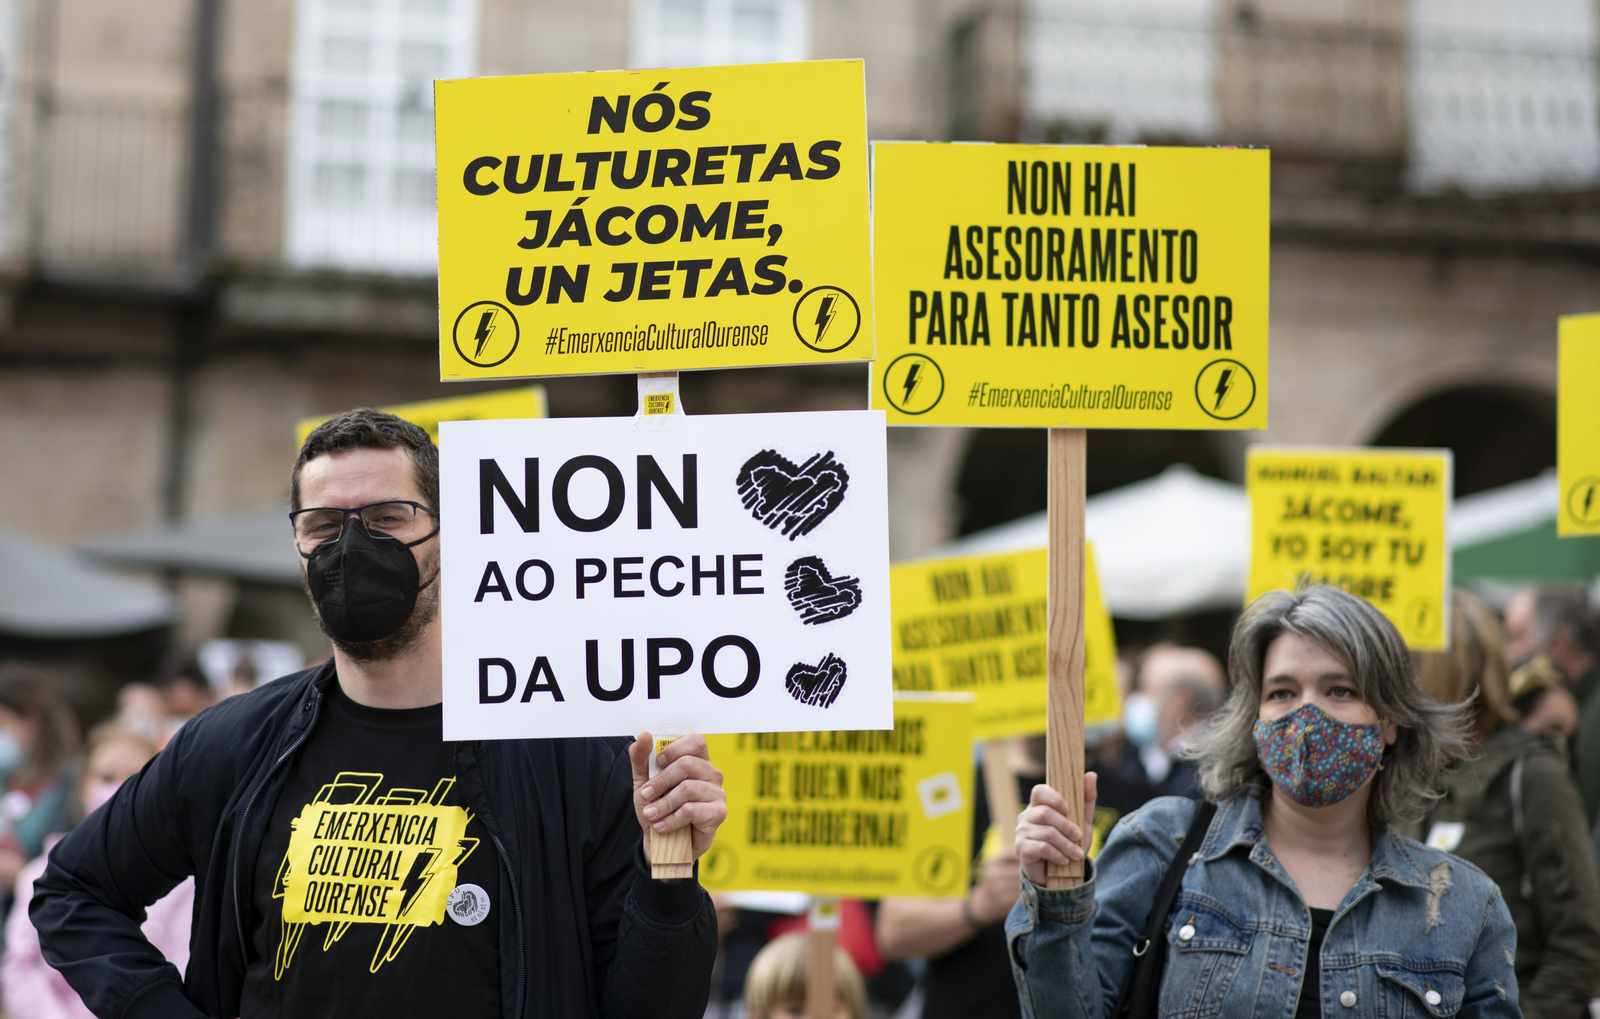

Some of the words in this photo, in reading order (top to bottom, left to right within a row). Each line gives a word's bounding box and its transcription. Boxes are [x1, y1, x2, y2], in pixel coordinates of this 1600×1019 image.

[587, 82, 712, 134] NÓS
[463, 140, 841, 196] CULTURETAS
[1007, 161, 1071, 215] NON
[1084, 163, 1136, 216] HAI
[517, 197, 783, 249] JÁCOME,
[505, 265, 589, 306] UN
[603, 255, 803, 302] JETAS.
[944, 226, 1198, 284] ASESORAMENTO
[545, 321, 769, 355] #EmerxenciaCulturalOurense
[909, 291, 991, 346] PARA
[1002, 293, 1100, 348] TANTO
[1110, 294, 1233, 351] ASESOR
[967, 382, 1173, 410] #EmerxenciaCulturalOurense
[480, 454, 698, 534] NON
[474, 559, 555, 602] AO
[576, 554, 765, 599] PECHE
[1388, 540, 1425, 565] TU
[478, 656, 565, 704] DA
[586, 635, 761, 701] UPO
[313, 811, 438, 846] EMERXENCIA
[308, 845, 402, 881] CULTURAL
[304, 881, 393, 917] OURENSE
